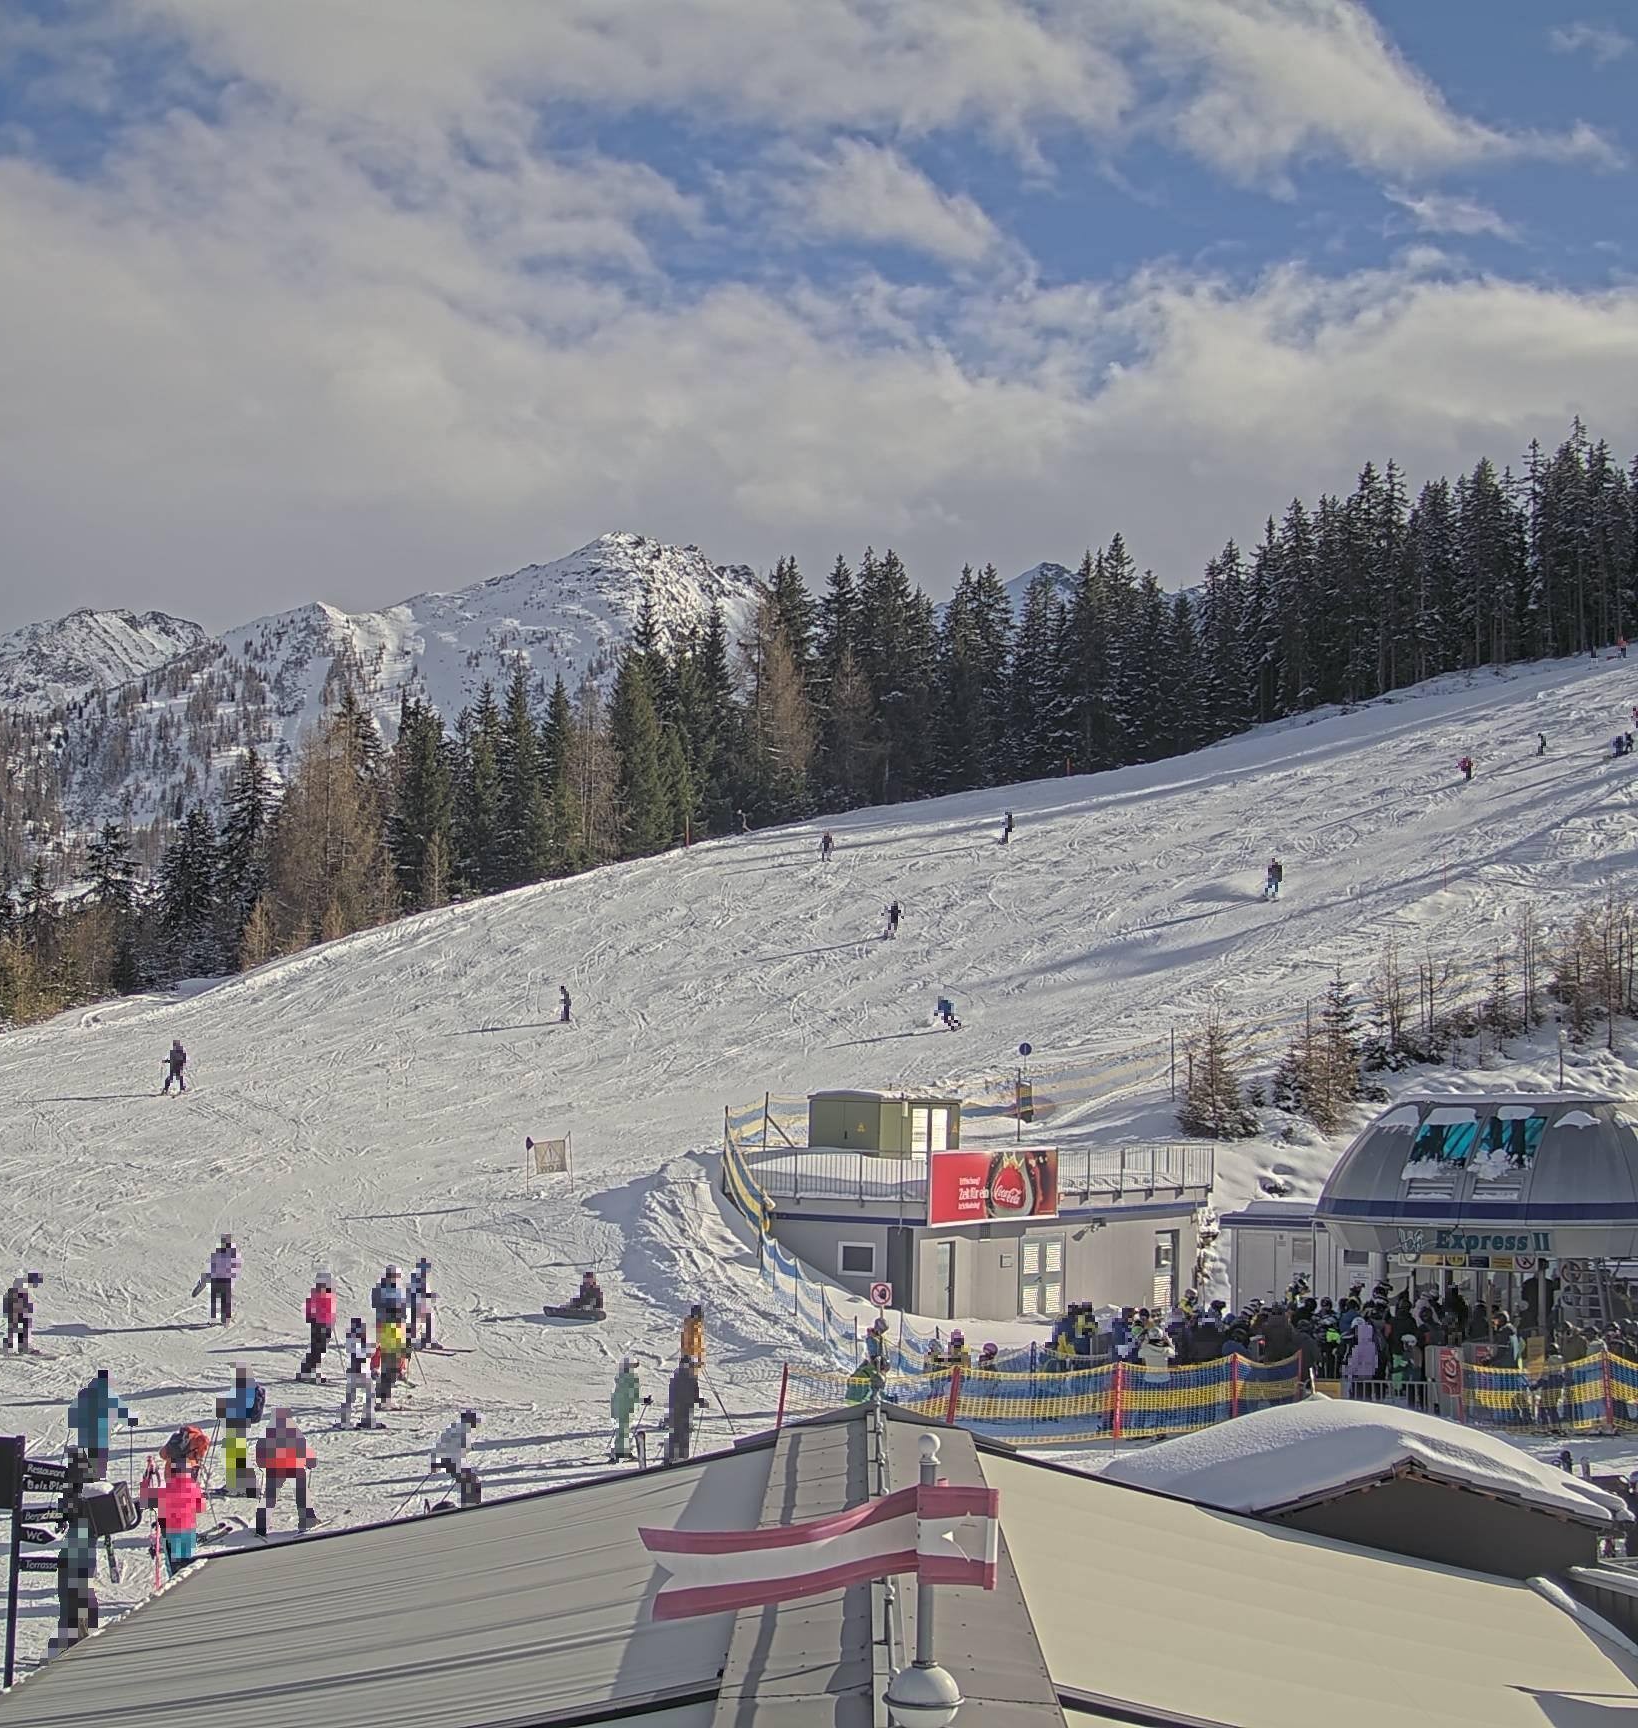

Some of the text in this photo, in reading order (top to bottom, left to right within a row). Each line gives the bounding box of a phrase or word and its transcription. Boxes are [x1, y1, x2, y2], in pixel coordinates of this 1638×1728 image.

[1435, 1230, 1529, 1254] Express
[26, 1531, 44, 1541] WC
[26, 1559, 58, 1570] Terrasse
